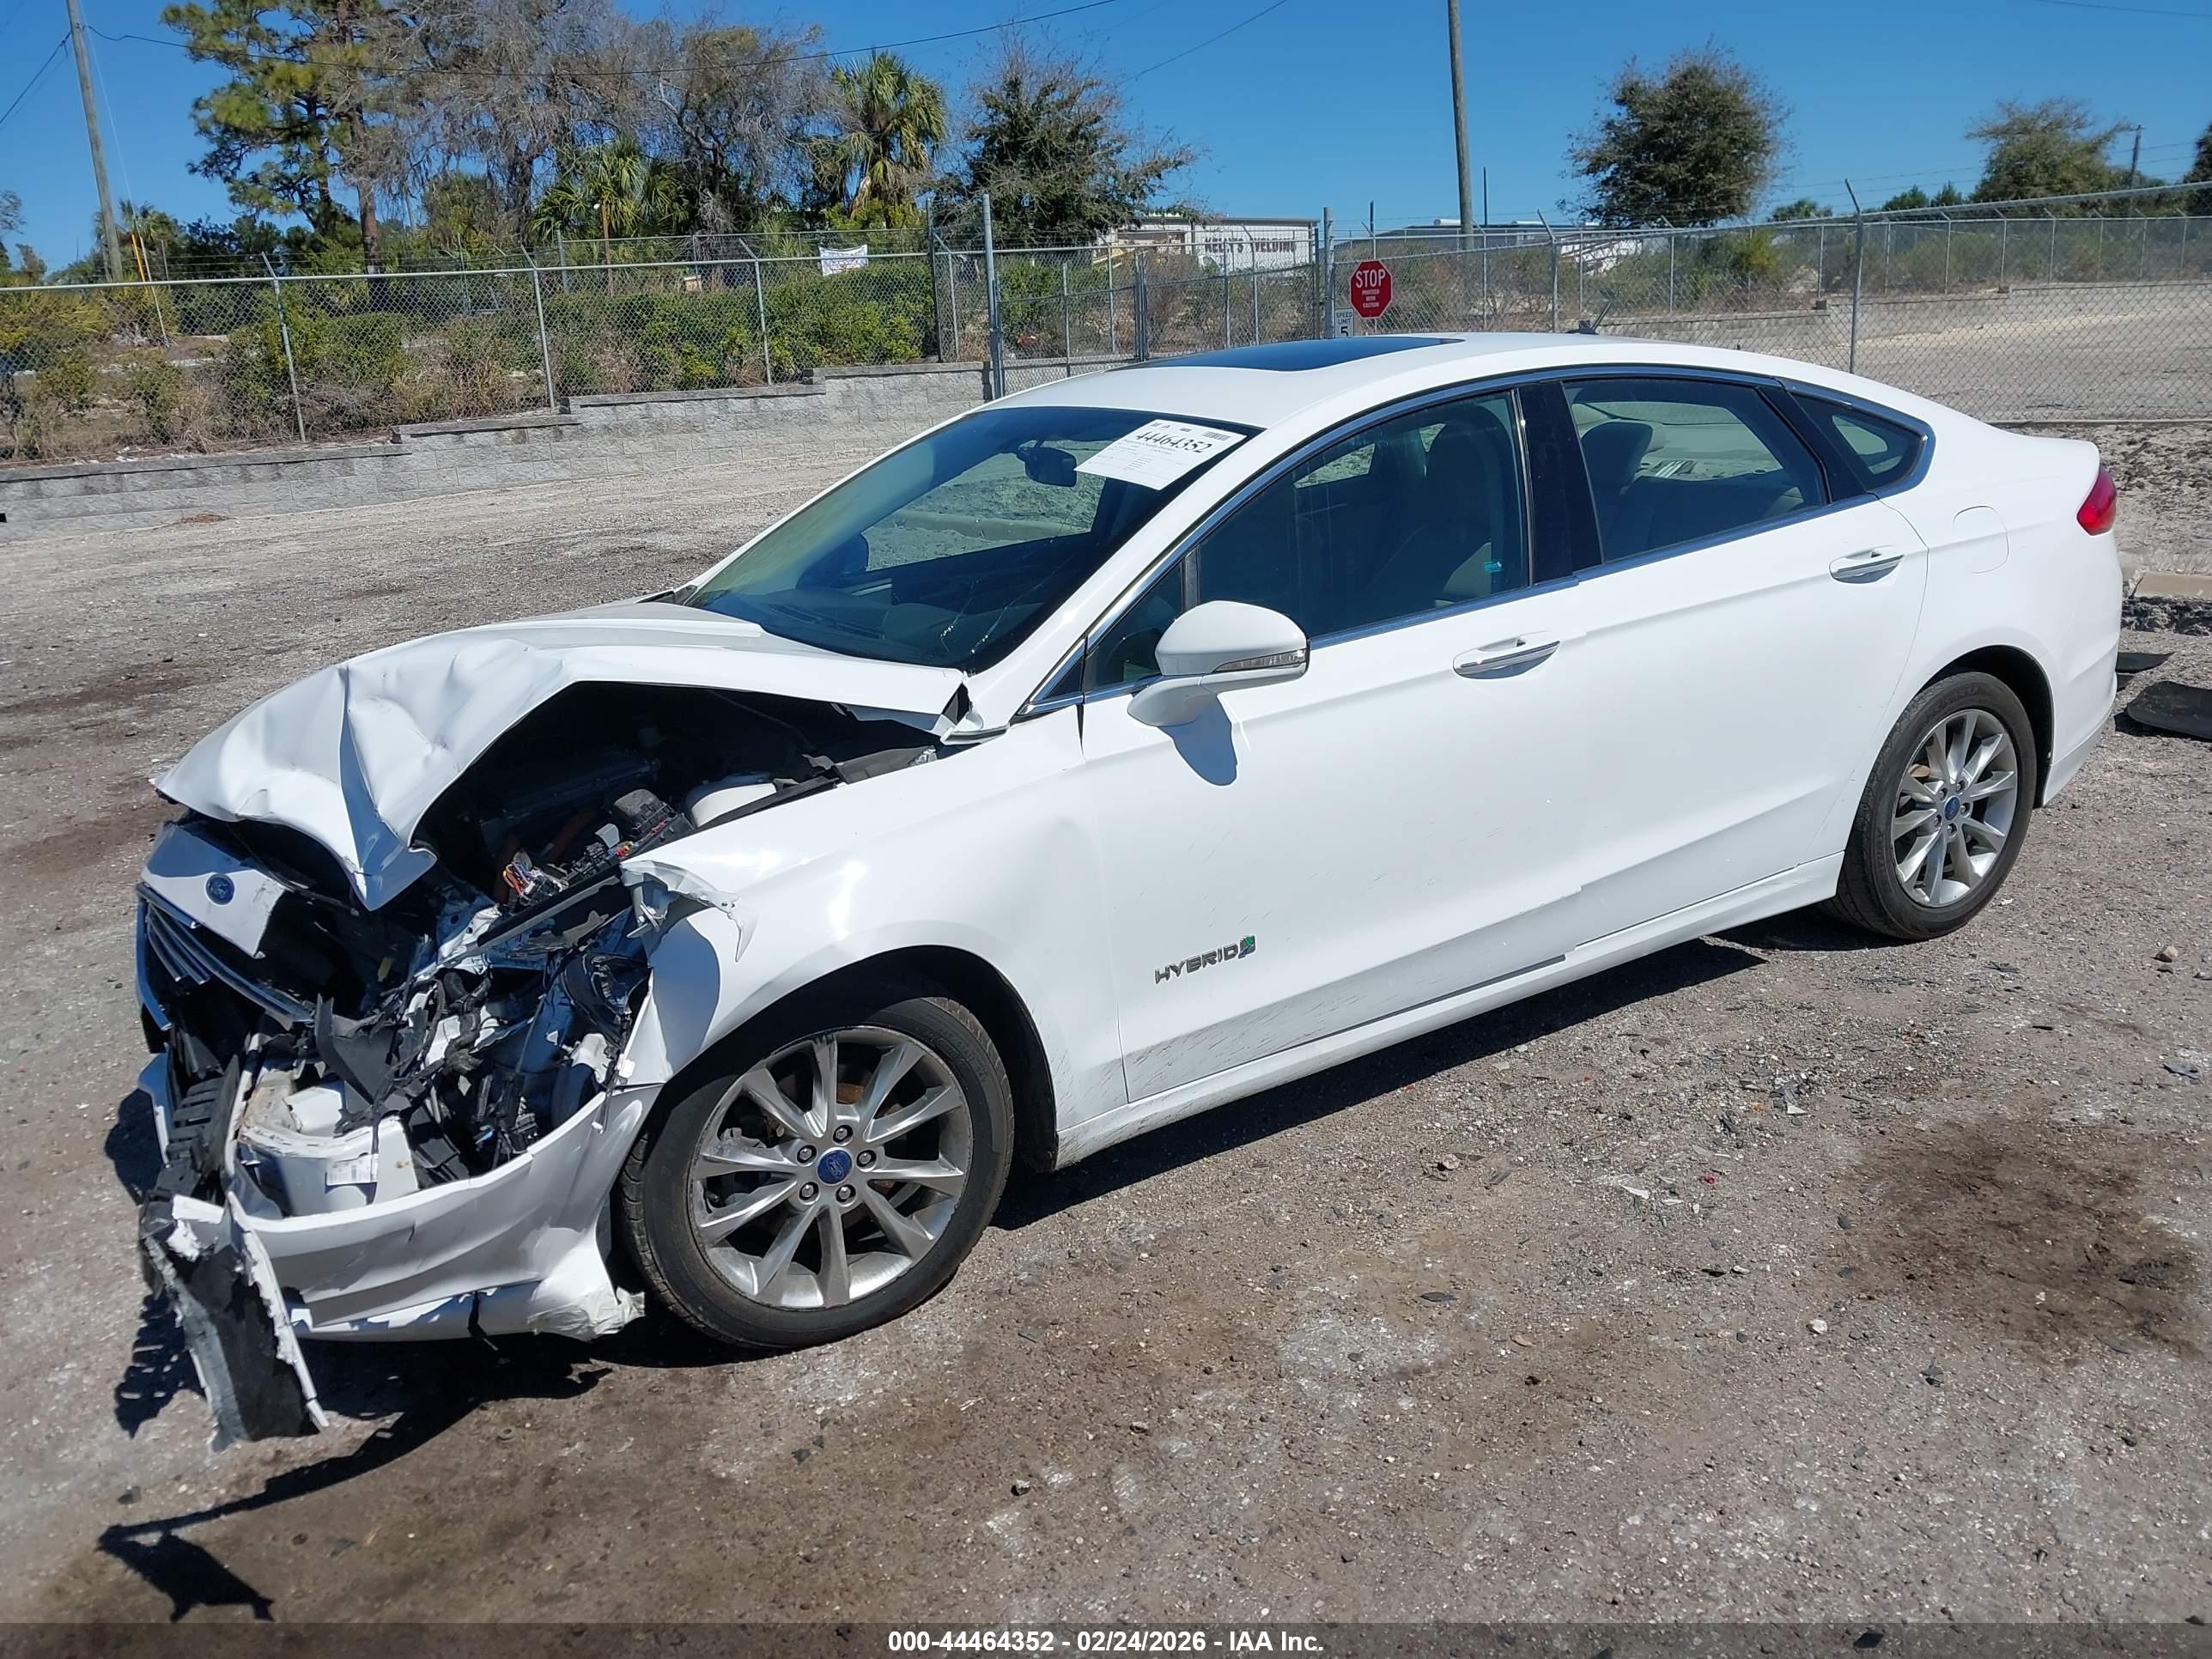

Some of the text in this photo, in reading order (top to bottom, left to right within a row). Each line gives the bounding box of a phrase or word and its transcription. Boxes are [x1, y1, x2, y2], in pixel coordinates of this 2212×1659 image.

[1356, 269, 1385, 288] STOP
[1340, 326, 1349, 337] 5
[1135, 431, 1213, 453] 44464352
[1154, 944, 1238, 985] HYBRID
